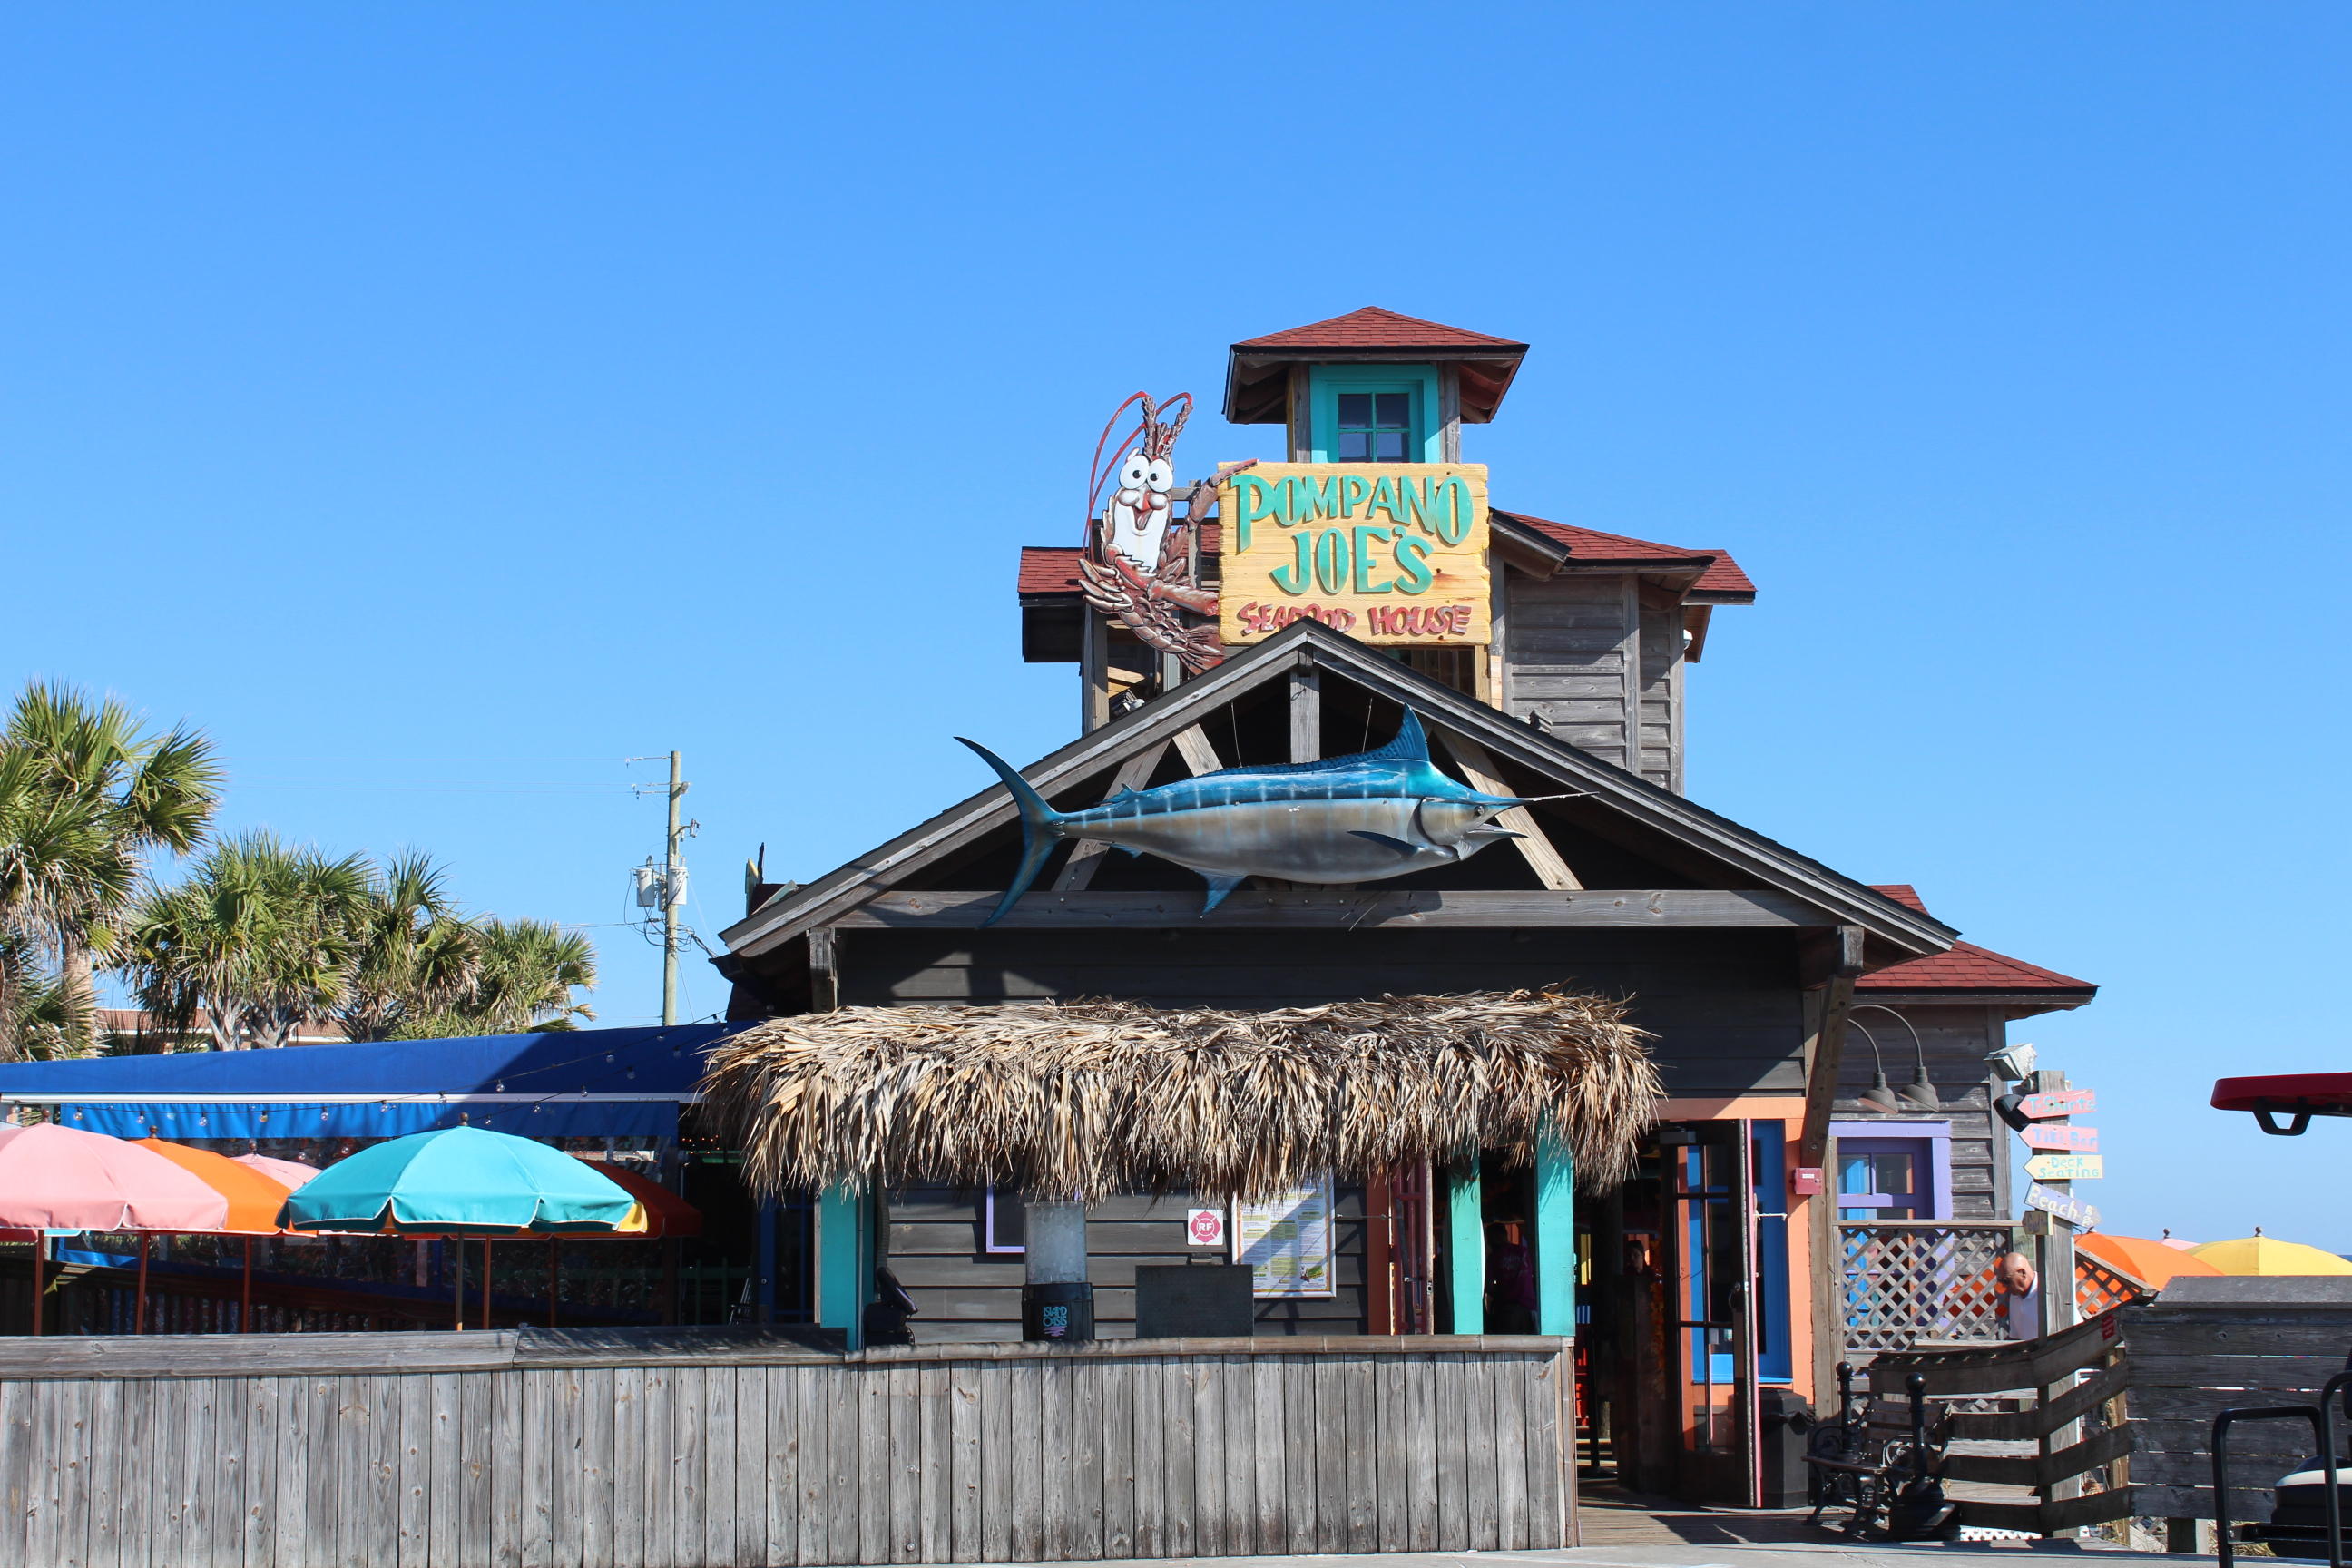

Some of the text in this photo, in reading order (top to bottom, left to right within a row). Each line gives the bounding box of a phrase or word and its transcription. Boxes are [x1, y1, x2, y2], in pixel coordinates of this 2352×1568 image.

[1230, 474, 1474, 554] POMPANO
[1270, 525, 1435, 594] JOE'S
[1368, 604, 1472, 636] HOUSE
[2028, 1095, 2097, 1114] T-Shirts
[2070, 1132, 2097, 1146] Bar
[2051, 1156, 2083, 1168] Deck
[1198, 1222, 1212, 1232] RF
[1043, 1316, 1067, 1327] OASIS
